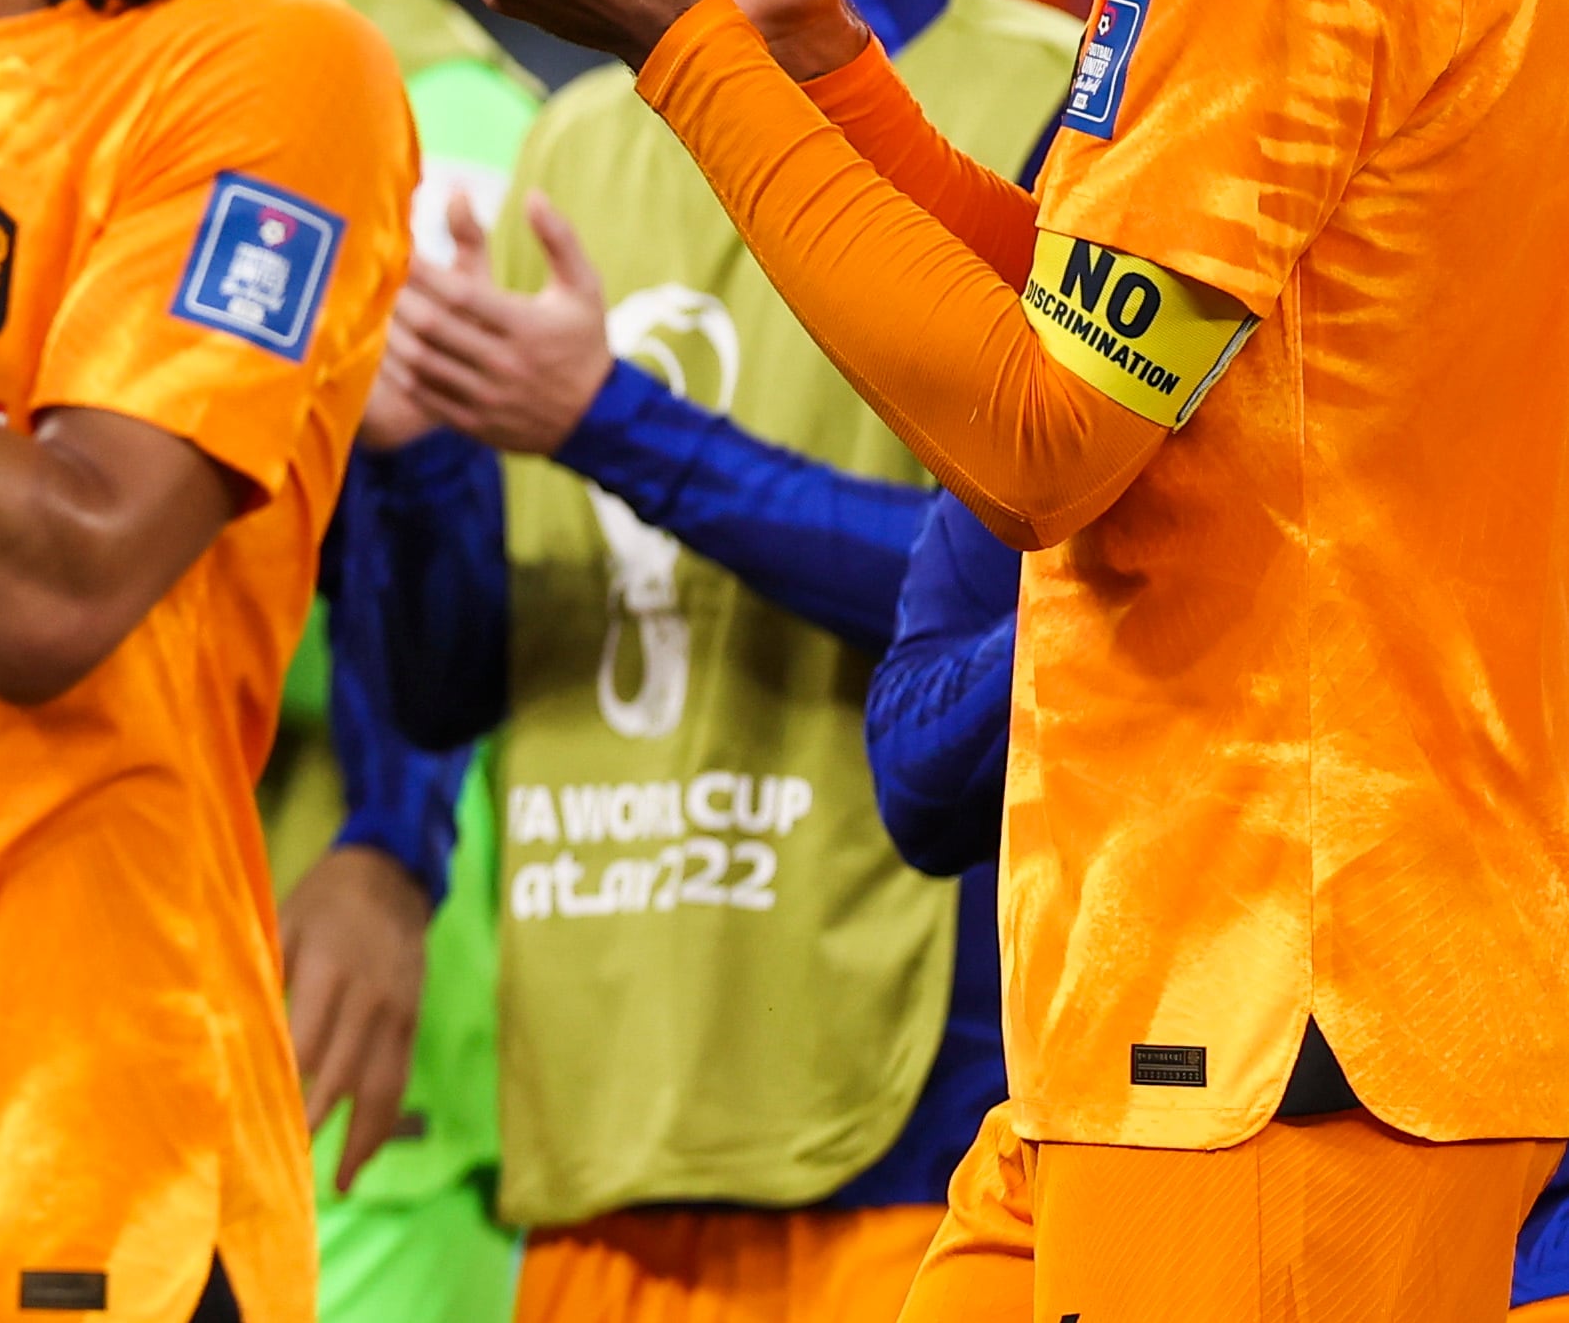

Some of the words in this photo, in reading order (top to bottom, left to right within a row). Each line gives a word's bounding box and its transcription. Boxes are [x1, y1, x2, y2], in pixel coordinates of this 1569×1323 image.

[1024, 279, 1181, 395] DISCRIMINATION
[1059, 238, 1162, 339] NO
[686, 770, 813, 836] CUP
